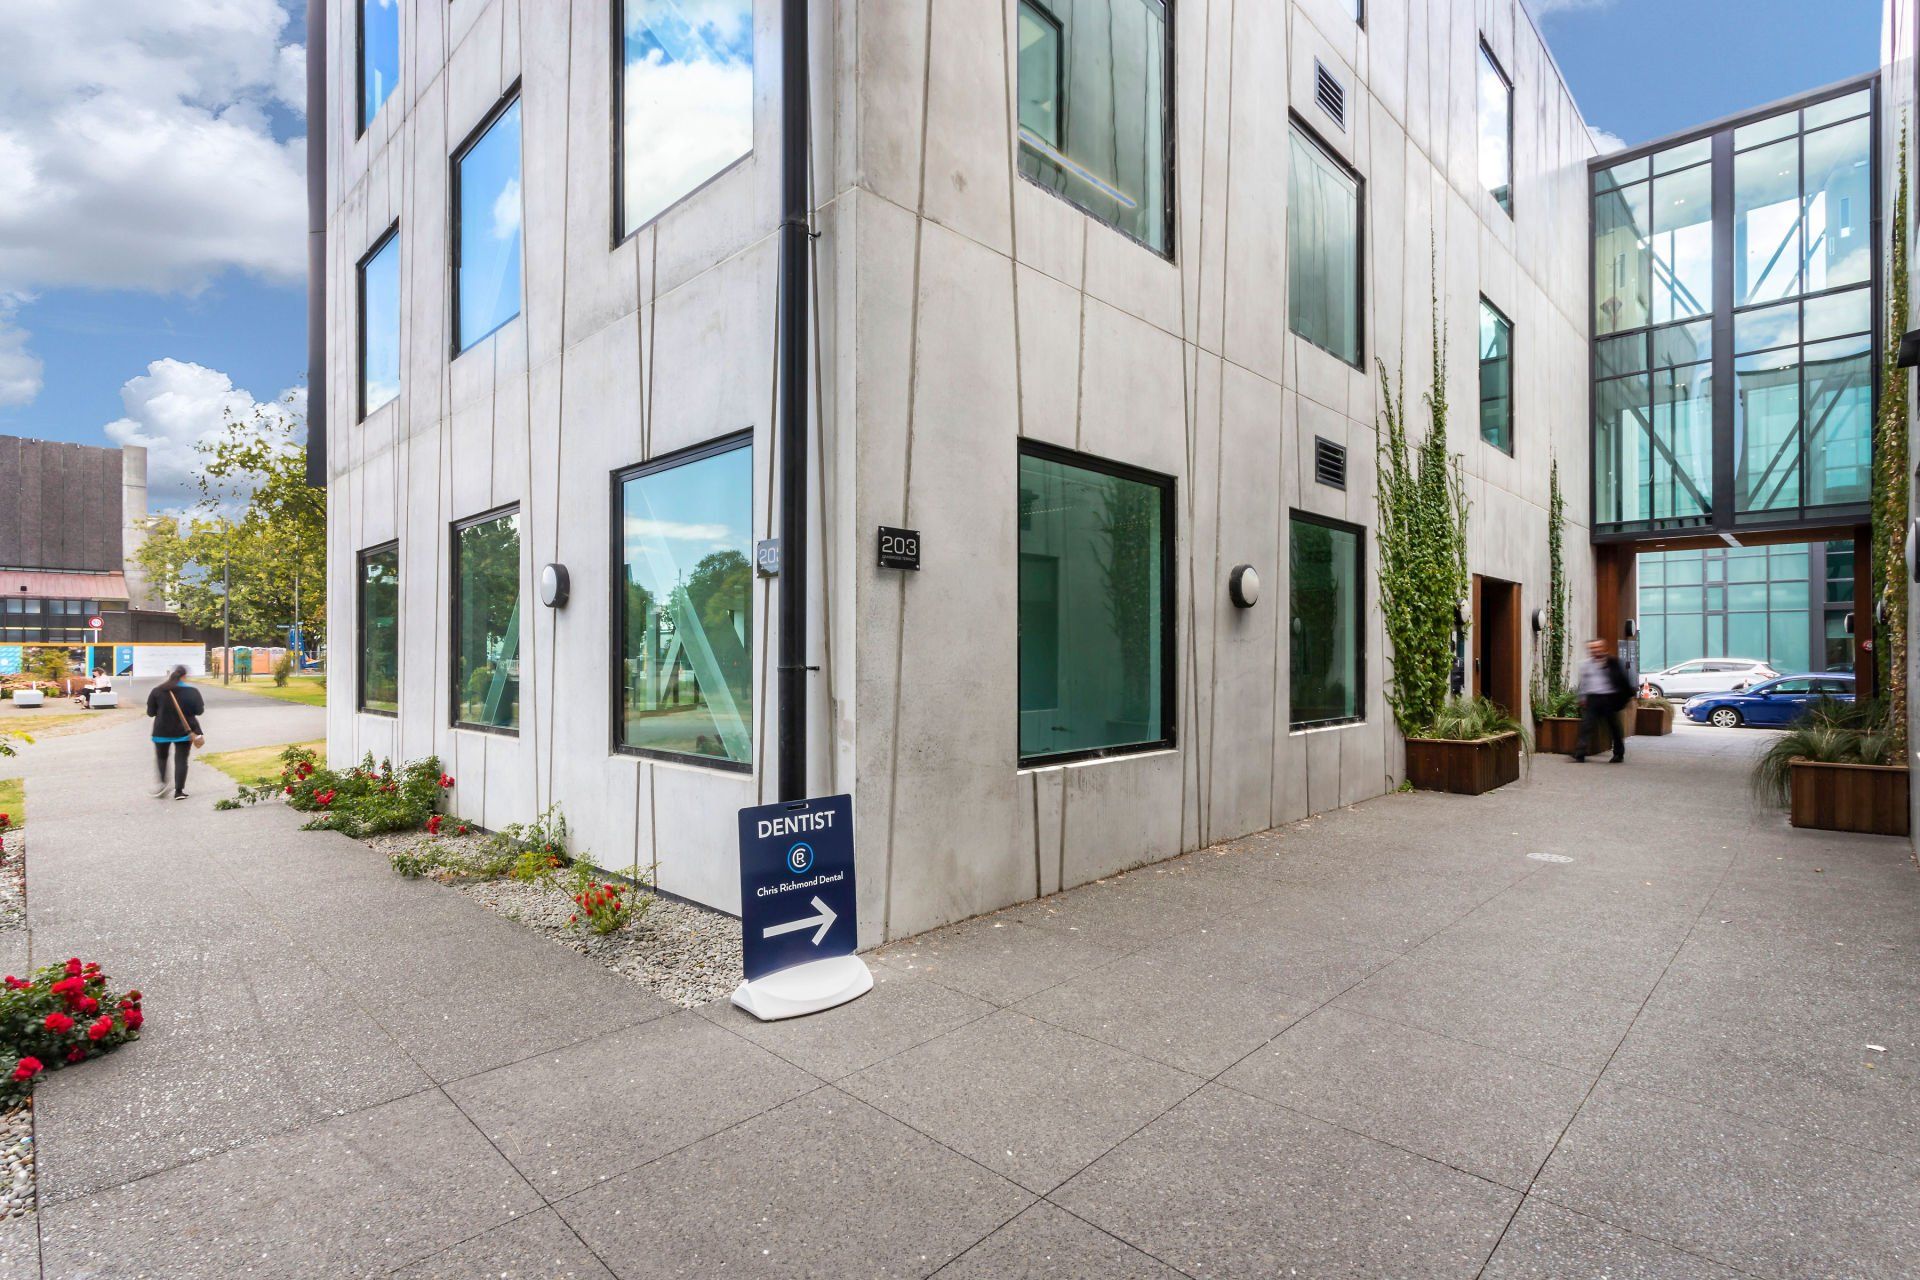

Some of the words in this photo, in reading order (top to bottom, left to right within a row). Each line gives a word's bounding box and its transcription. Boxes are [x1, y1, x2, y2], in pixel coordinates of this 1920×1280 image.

[759, 547, 778, 565] 20
[882, 535, 917, 556] 203
[758, 810, 836, 839] DENTIST
[757, 886, 778, 897] Chris
[780, 876, 818, 893] Richmond
[819, 870, 844, 884] Dental
